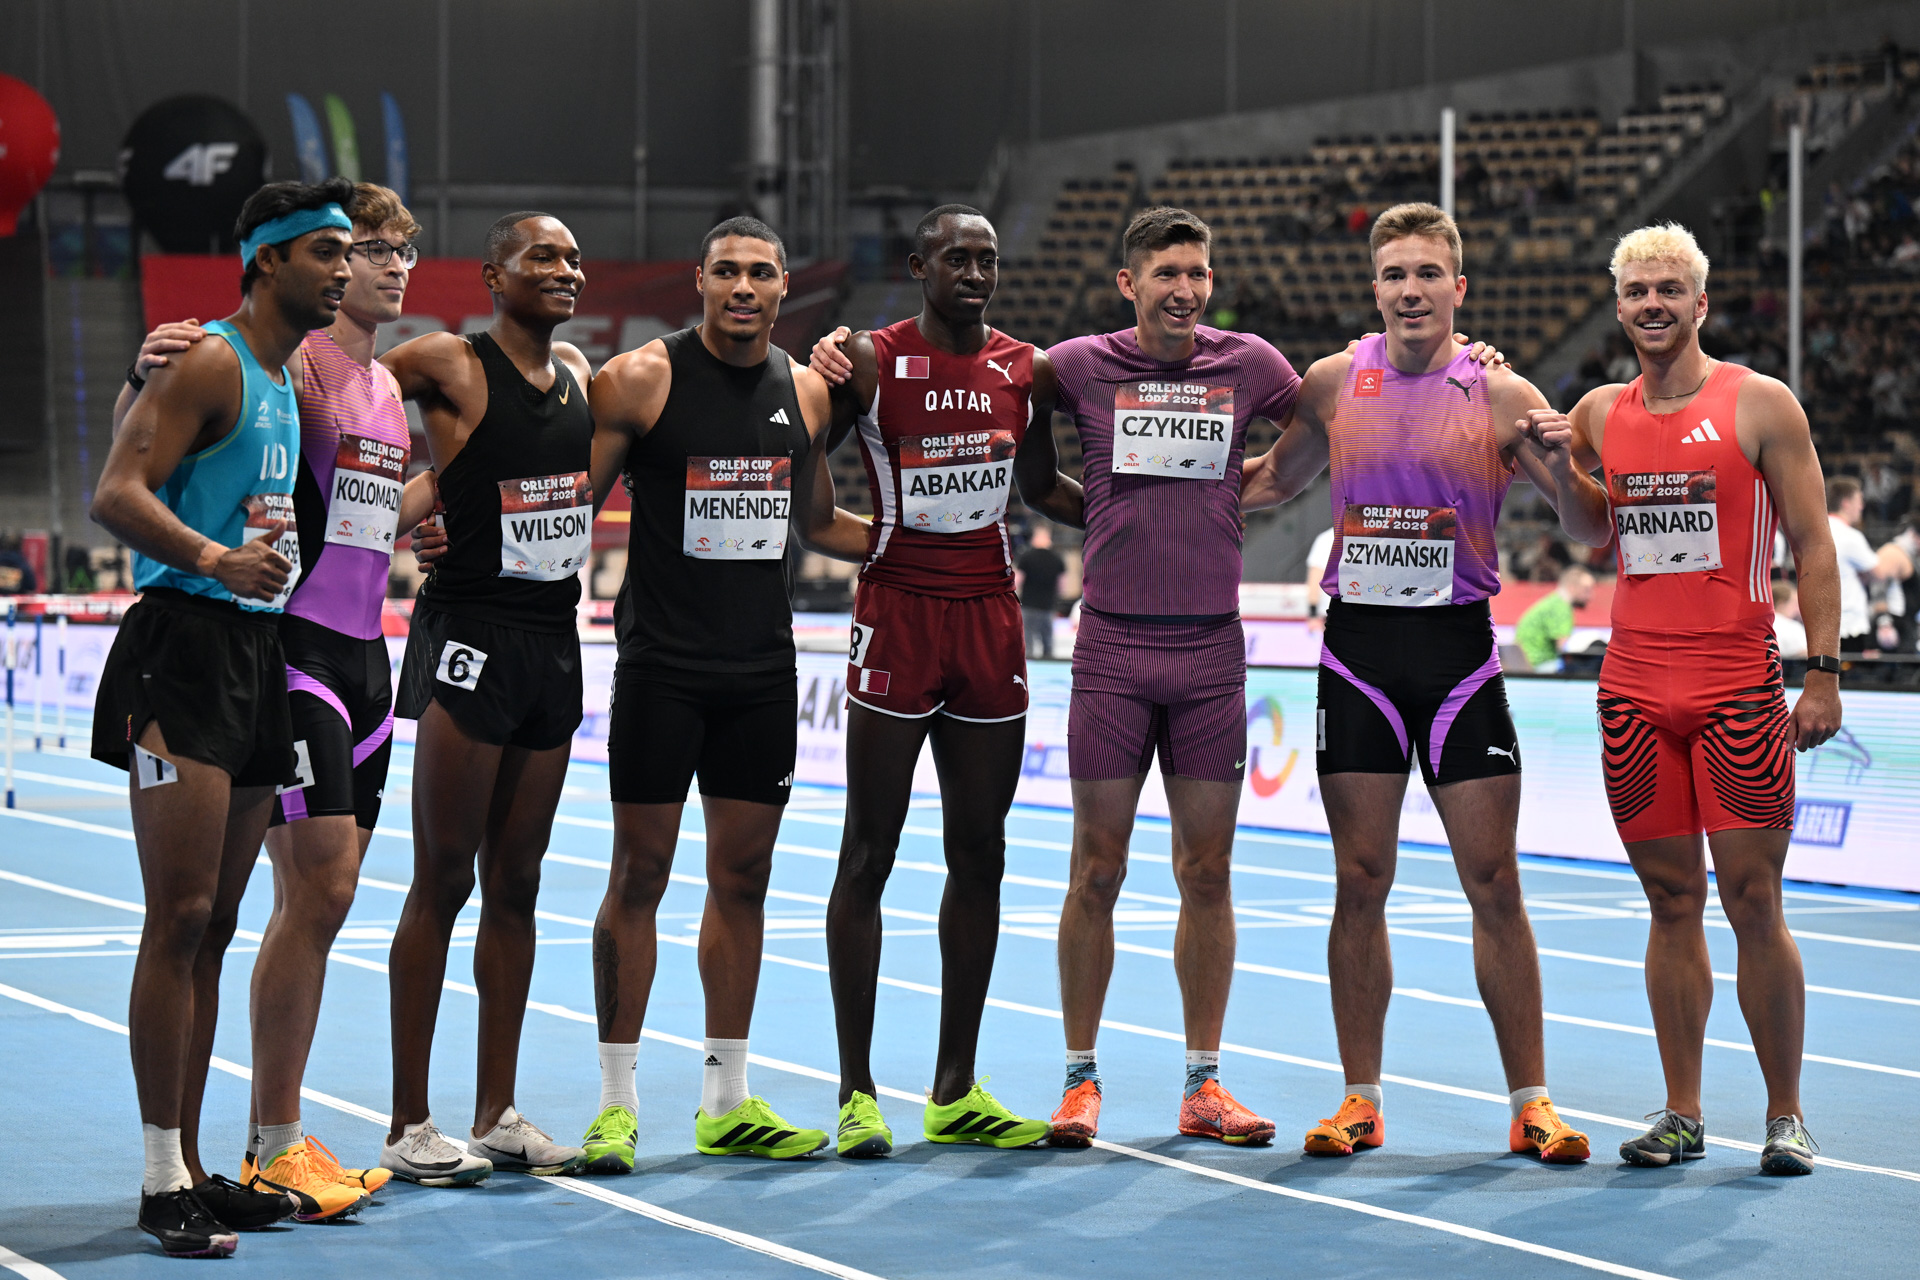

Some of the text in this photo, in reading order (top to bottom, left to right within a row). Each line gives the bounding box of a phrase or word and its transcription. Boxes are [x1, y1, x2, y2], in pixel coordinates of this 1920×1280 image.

[163, 143, 238, 185] 4F
[1138, 383, 1207, 395] ORLEN CUP
[925, 389, 992, 414] QATAR
[1173, 395, 1207, 405] 2026
[1122, 416, 1224, 442] CZYKIER
[922, 433, 990, 448] ORLEN CUP
[360, 439, 404, 460] ORLEN CUP
[957, 445, 991, 456] 2026
[382, 458, 403, 473] 2026
[709, 460, 772, 470] ORLEN CUP
[1180, 459, 1196, 468] 4F
[742, 473, 772, 481] 2026
[910, 467, 1006, 497] ABAKAR
[1627, 474, 1689, 486] ORLEN CUP
[521, 476, 575, 491] ORLEN CUP
[552, 489, 576, 500] 2026
[1657, 487, 1689, 496] 2026
[690, 493, 788, 519] MENÉNDEZ
[969, 510, 985, 520] 4F
[1363, 507, 1429, 519] ORLEN CUP
[511, 513, 586, 543] WILSON
[1393, 521, 1428, 531] 2026
[1617, 511, 1713, 536] BARNARD
[383, 532, 392, 542] 4F
[751, 540, 767, 549] 4F
[1344, 541, 1448, 568] SZYMAŃSKI
[1670, 553, 1687, 563] 4F
[561, 558, 572, 568] 4F
[1400, 587, 1418, 596] 4F
[849, 626, 863, 661] 8
[448, 648, 474, 682] 6
[1342, 1120, 1375, 1141] NITRO
[1523, 1124, 1551, 1144] NITRO
